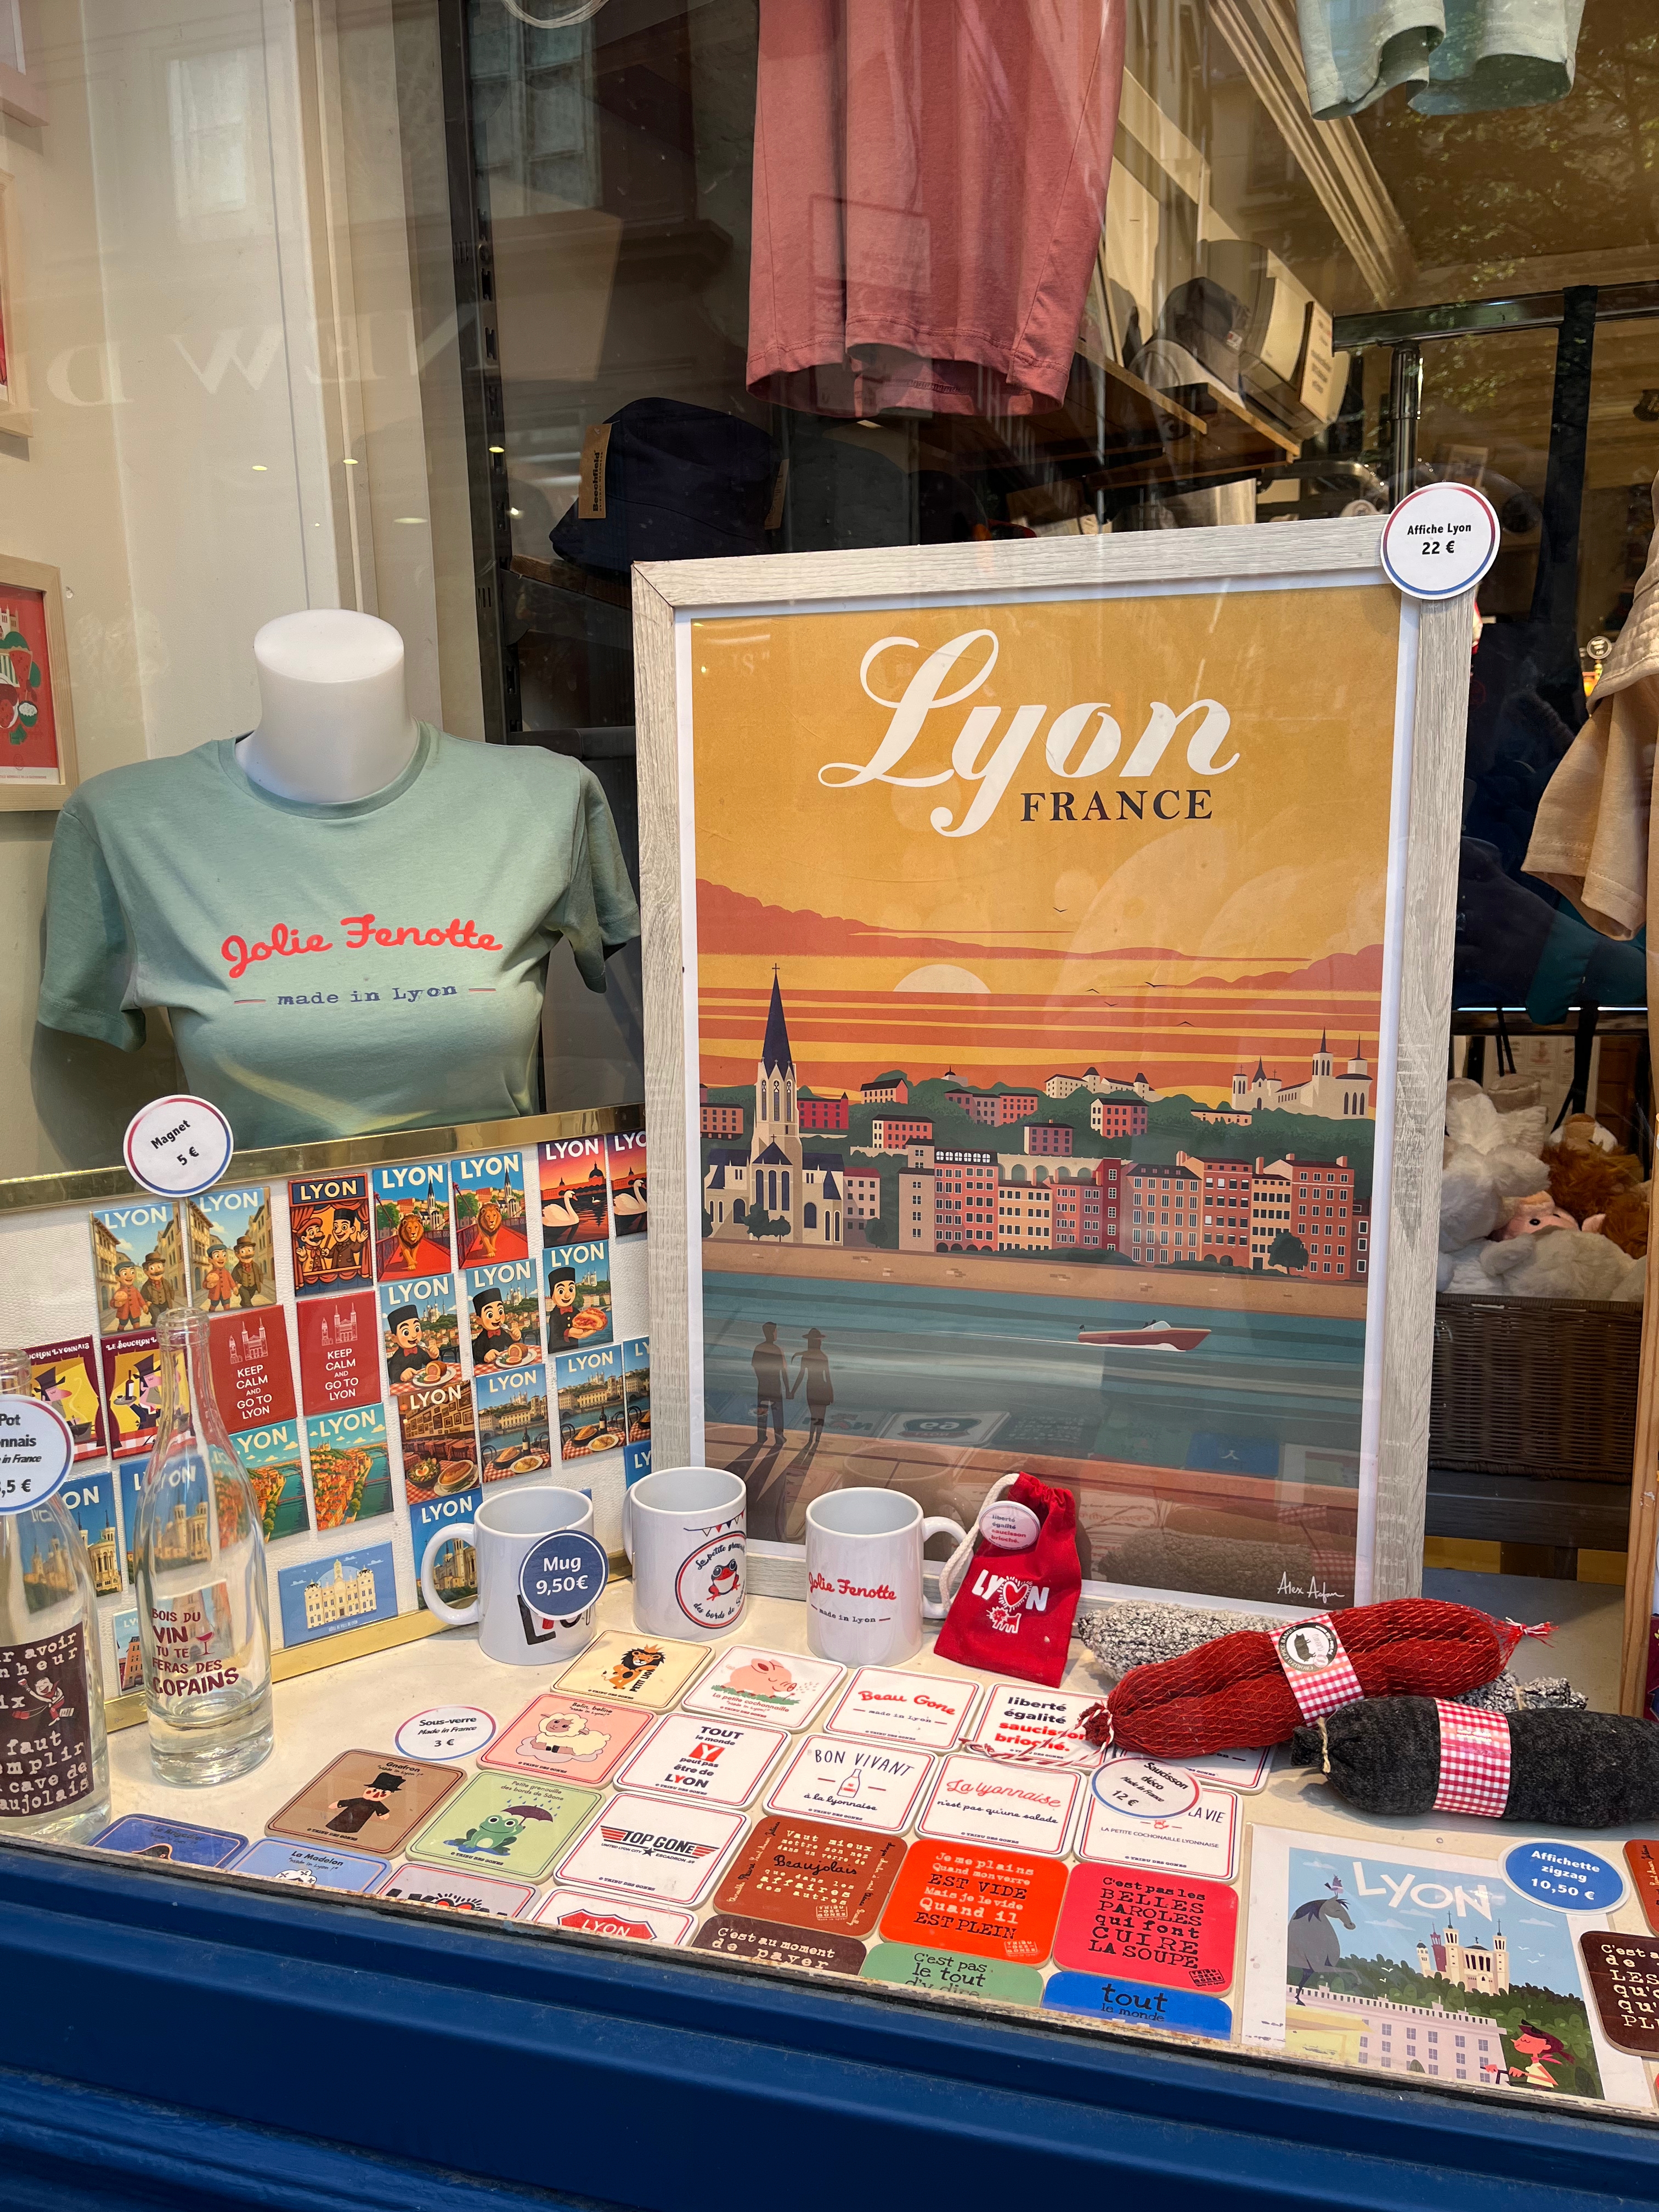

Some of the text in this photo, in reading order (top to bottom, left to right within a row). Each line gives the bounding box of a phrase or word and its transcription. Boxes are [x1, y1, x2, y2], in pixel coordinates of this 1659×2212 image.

[1407, 523, 1471, 535] Affiche Lyon
[1422, 540, 1455, 555] 22 €
[817, 629, 1240, 837] Lyon
[1020, 789, 1212, 822] FRANCE
[221, 913, 503, 978] Jolie Fenotte
[276, 985, 458, 1006] made in Lyon
[150, 1119, 191, 1149] Magnet
[614, 1131, 646, 1152] LYO
[177, 1146, 199, 1166] 5 €
[545, 1138, 599, 1161] LYON
[382, 1166, 444, 1189] LYON
[460, 1154, 520, 1179] LYON
[300, 1180, 357, 1200] LYON
[199, 1192, 258, 1213] LYON
[104, 1206, 167, 1229] LYON
[551, 1243, 605, 1268] LYON
[474, 1261, 532, 1288] LYON
[388, 1278, 449, 1306] LYON
[28, 1342, 90, 1360] UCHON LYONNAIS
[106, 1343, 117, 1351] LE
[117, 1340, 150, 1350] BOUCHON
[326, 1347, 352, 1361] KEEP
[237, 1364, 264, 1378] KEEP
[325, 1358, 356, 1372] CALM
[568, 1351, 614, 1373] LYON
[236, 1375, 268, 1389] CALM
[246, 1387, 261, 1396] AND
[325, 1377, 359, 1391] GO TO
[489, 1370, 537, 1393] LYON
[236, 1394, 272, 1410] GO TO
[329, 1388, 356, 1401] LYON
[410, 1384, 462, 1410] LYON
[241, 1406, 270, 1420] LYON
[319, 1409, 376, 1437] LYON
[421, 1496, 473, 1524] LYON
[543, 1556, 581, 1575] Mug
[535, 1574, 589, 1596] 9,50€
[809, 1571, 897, 1600] Jolie Fenotte
[1277, 1571, 1304, 1594] Alex
[151, 1607, 201, 1622] BOIS DU
[25, 1632, 77, 1659] avoir
[153, 1625, 189, 1644] VIN
[156, 1645, 189, 1658] TU TE
[152, 1657, 222, 1674] FERAS DES
[153, 1667, 239, 1696] COPAINS
[629, 1679, 646, 1692] PETIT
[744, 1700, 789, 1712] cochonnaille
[857, 1690, 956, 1716] Beau Gone
[1007, 1696, 1066, 1711] liberté
[419, 1717, 477, 1726] Sous-verre
[1003, 1709, 1066, 1724] égalité
[7, 1730, 62, 1756] faut
[701, 1726, 744, 1739] TOUT
[386, 1762, 421, 1773] Gnafron
[674, 1764, 697, 1773] être
[815, 1749, 915, 1777] BON VIVANT
[664, 1774, 709, 1788] LYON
[1141, 1775, 1164, 1791] déco
[1143, 1762, 1189, 1790] Saucisson
[529, 1784, 562, 1795] grenouille
[946, 1779, 1061, 1808] La lyonnaise
[813, 1793, 826, 1803] la
[828, 1796, 878, 1813] lyonnaise
[937, 1799, 1059, 1824] n'est pas qu'une salade
[622, 1831, 696, 1854] TOP GONE
[781, 1838, 869, 1860] mettre son nez
[786, 1830, 873, 1853] Vaut mieux
[1133, 1831, 1181, 1842] COCHONAILLE
[1182, 1838, 1220, 1848] LYONNAISE
[305, 1853, 344, 1866] Madelon
[656, 1853, 686, 1862] ESCADRON
[774, 1855, 857, 1876] Beaujolais
[935, 1852, 1035, 1876] Je me plains
[1531, 1850, 1600, 1872] Affichette
[933, 1863, 1031, 1886] Quand mon verre
[1541, 1866, 1587, 1883] zigzag
[756, 1882, 847, 1905] des autres
[760, 1875, 851, 1899] affaires
[927, 1874, 1028, 1900] EST VIDE
[1103, 1877, 1205, 1900] C'est pas les
[1352, 1861, 1493, 1922] LYON
[1531, 1878, 1595, 1900] 10,50 €
[919, 1897, 1019, 1925] Quand il
[1099, 1888, 1204, 1914] BELLES
[1097, 1900, 1202, 1927] PAROLES
[913, 1911, 1017, 1940] EST PLEIN
[1095, 1914, 1200, 1939] qui font
[718, 1927, 836, 1959] C'est au moment
[1092, 1926, 1198, 1955] CUIRE
[1601, 1944, 1646, 1957] C'est
[914, 1953, 988, 1973] C'est pas
[1087, 1939, 1199, 1970] LA SOUPE
[912, 1963, 986, 1987] le tout
[1101, 1983, 1169, 2013] tout
[1101, 2002, 1165, 2023] le monde
